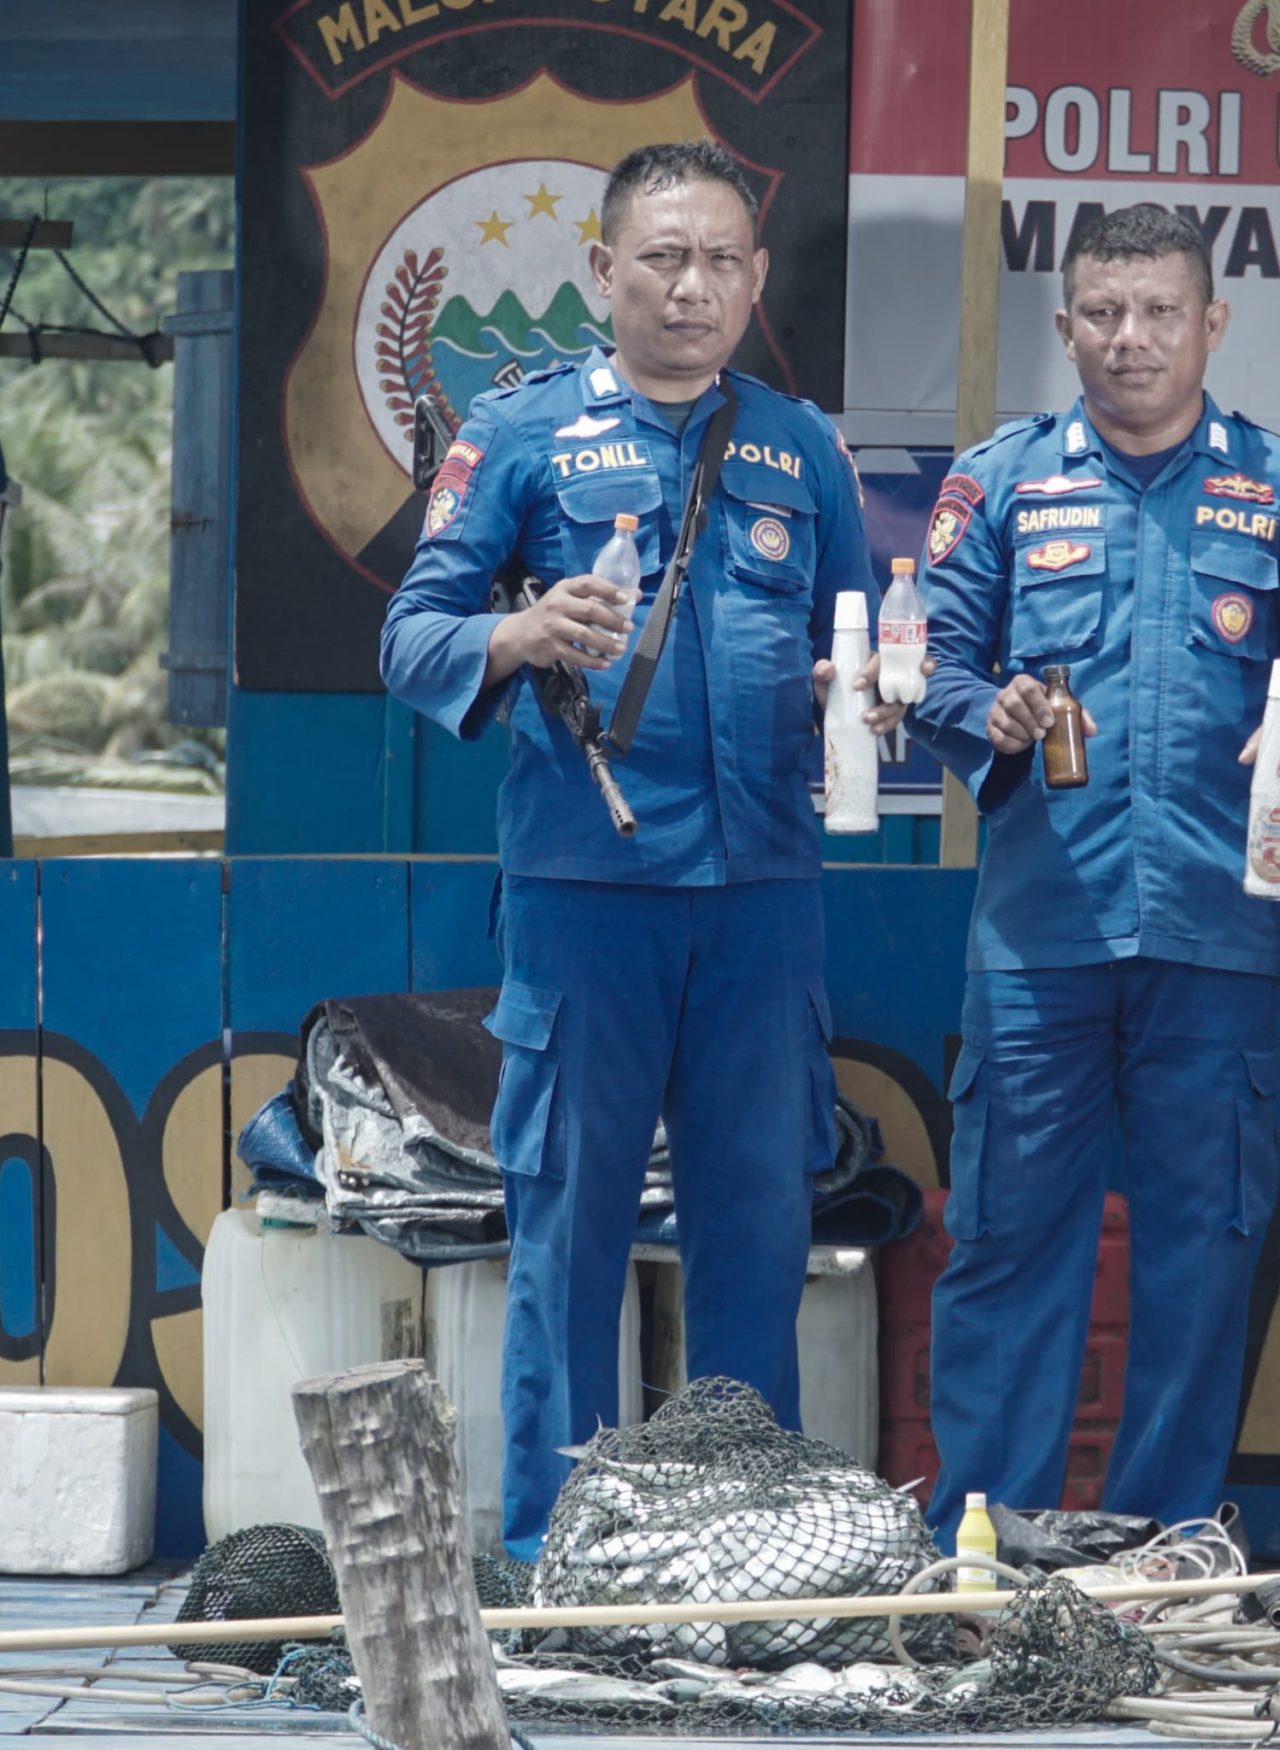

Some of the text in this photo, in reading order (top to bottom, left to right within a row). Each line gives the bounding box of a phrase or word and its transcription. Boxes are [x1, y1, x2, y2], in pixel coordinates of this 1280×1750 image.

[1004, 83, 1243, 177] POLRI
[1017, 504, 1100, 533] SAFRUDIN
[1195, 504, 1278, 541] POLRI
